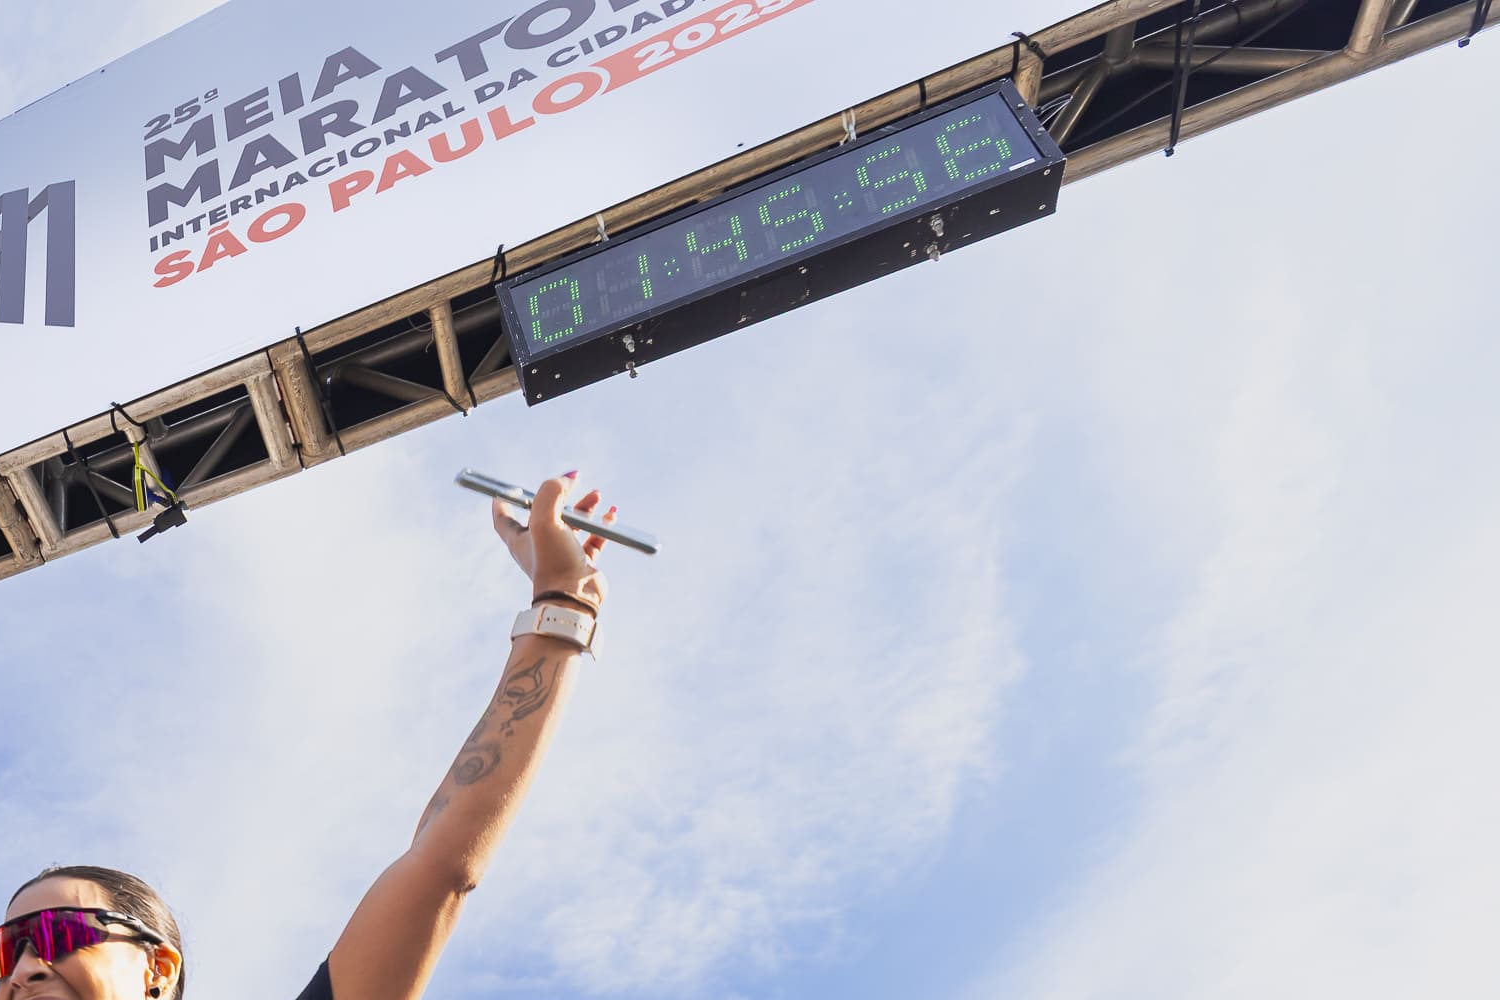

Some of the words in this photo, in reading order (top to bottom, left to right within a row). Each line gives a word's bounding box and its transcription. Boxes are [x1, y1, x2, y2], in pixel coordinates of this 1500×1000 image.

[144, 88, 218, 140] 25ª
[145, 46, 382, 181] MEIA
[147, 0, 640, 228] MARATO
[150, 101, 465, 252] INTERNACIONAL
[474, 68, 537, 103] DA
[152, 202, 307, 288] SÃO
[328, 72, 603, 213] PAULO
